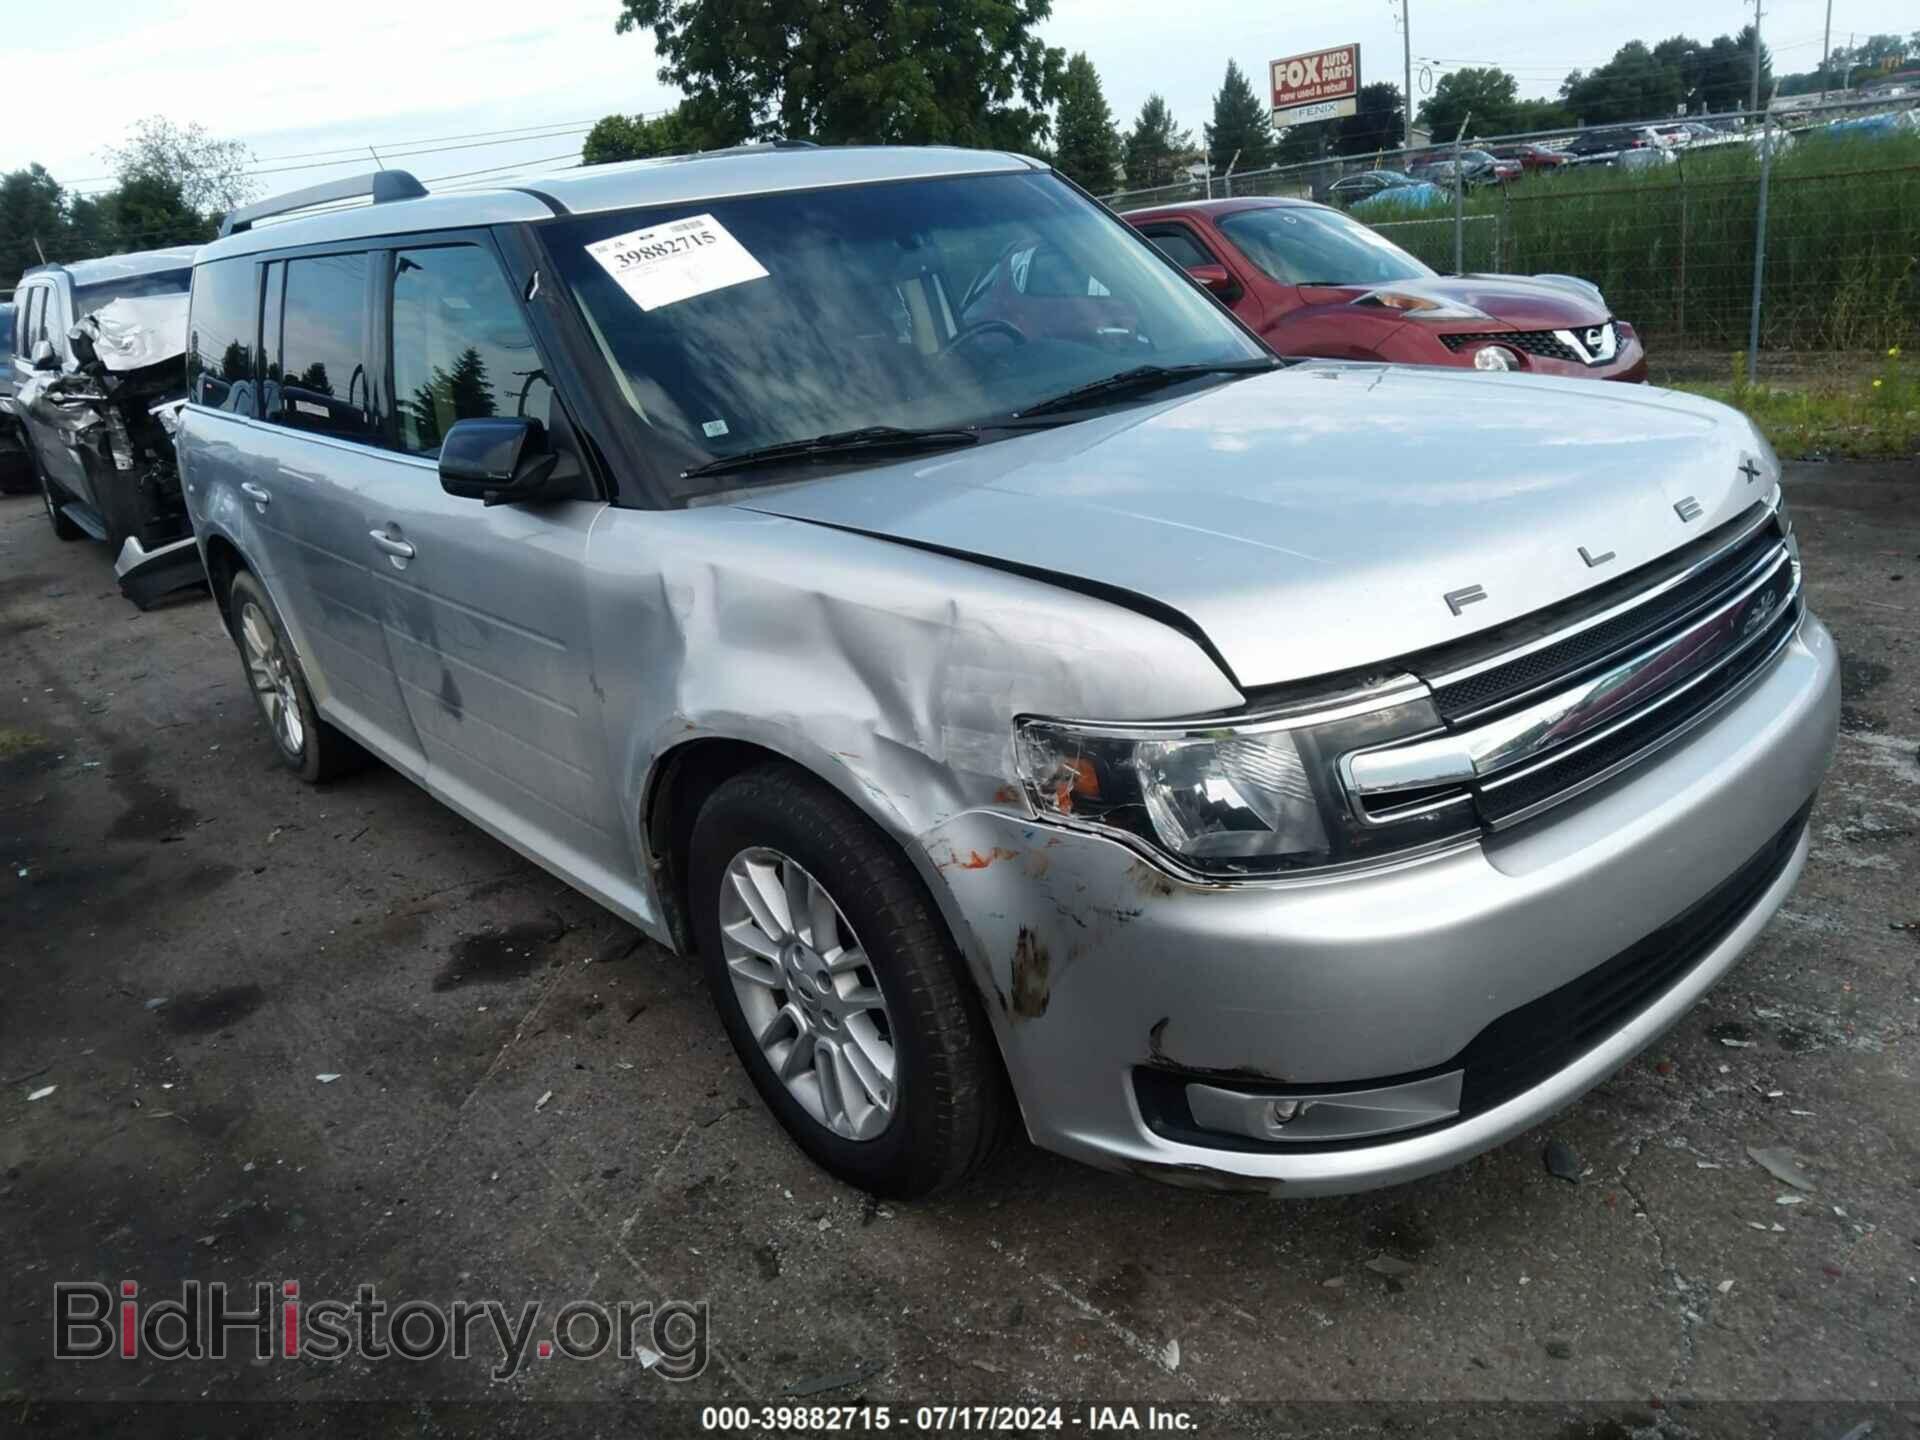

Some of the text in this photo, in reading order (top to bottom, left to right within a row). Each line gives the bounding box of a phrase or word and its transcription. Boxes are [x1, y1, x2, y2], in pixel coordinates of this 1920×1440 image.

[1322, 51, 1349, 67] AUTO
[1274, 57, 1320, 91] FOX
[1322, 64, 1352, 82] PARTS
[1298, 103, 1336, 117] FENIX
[614, 231, 717, 268] 39882715
